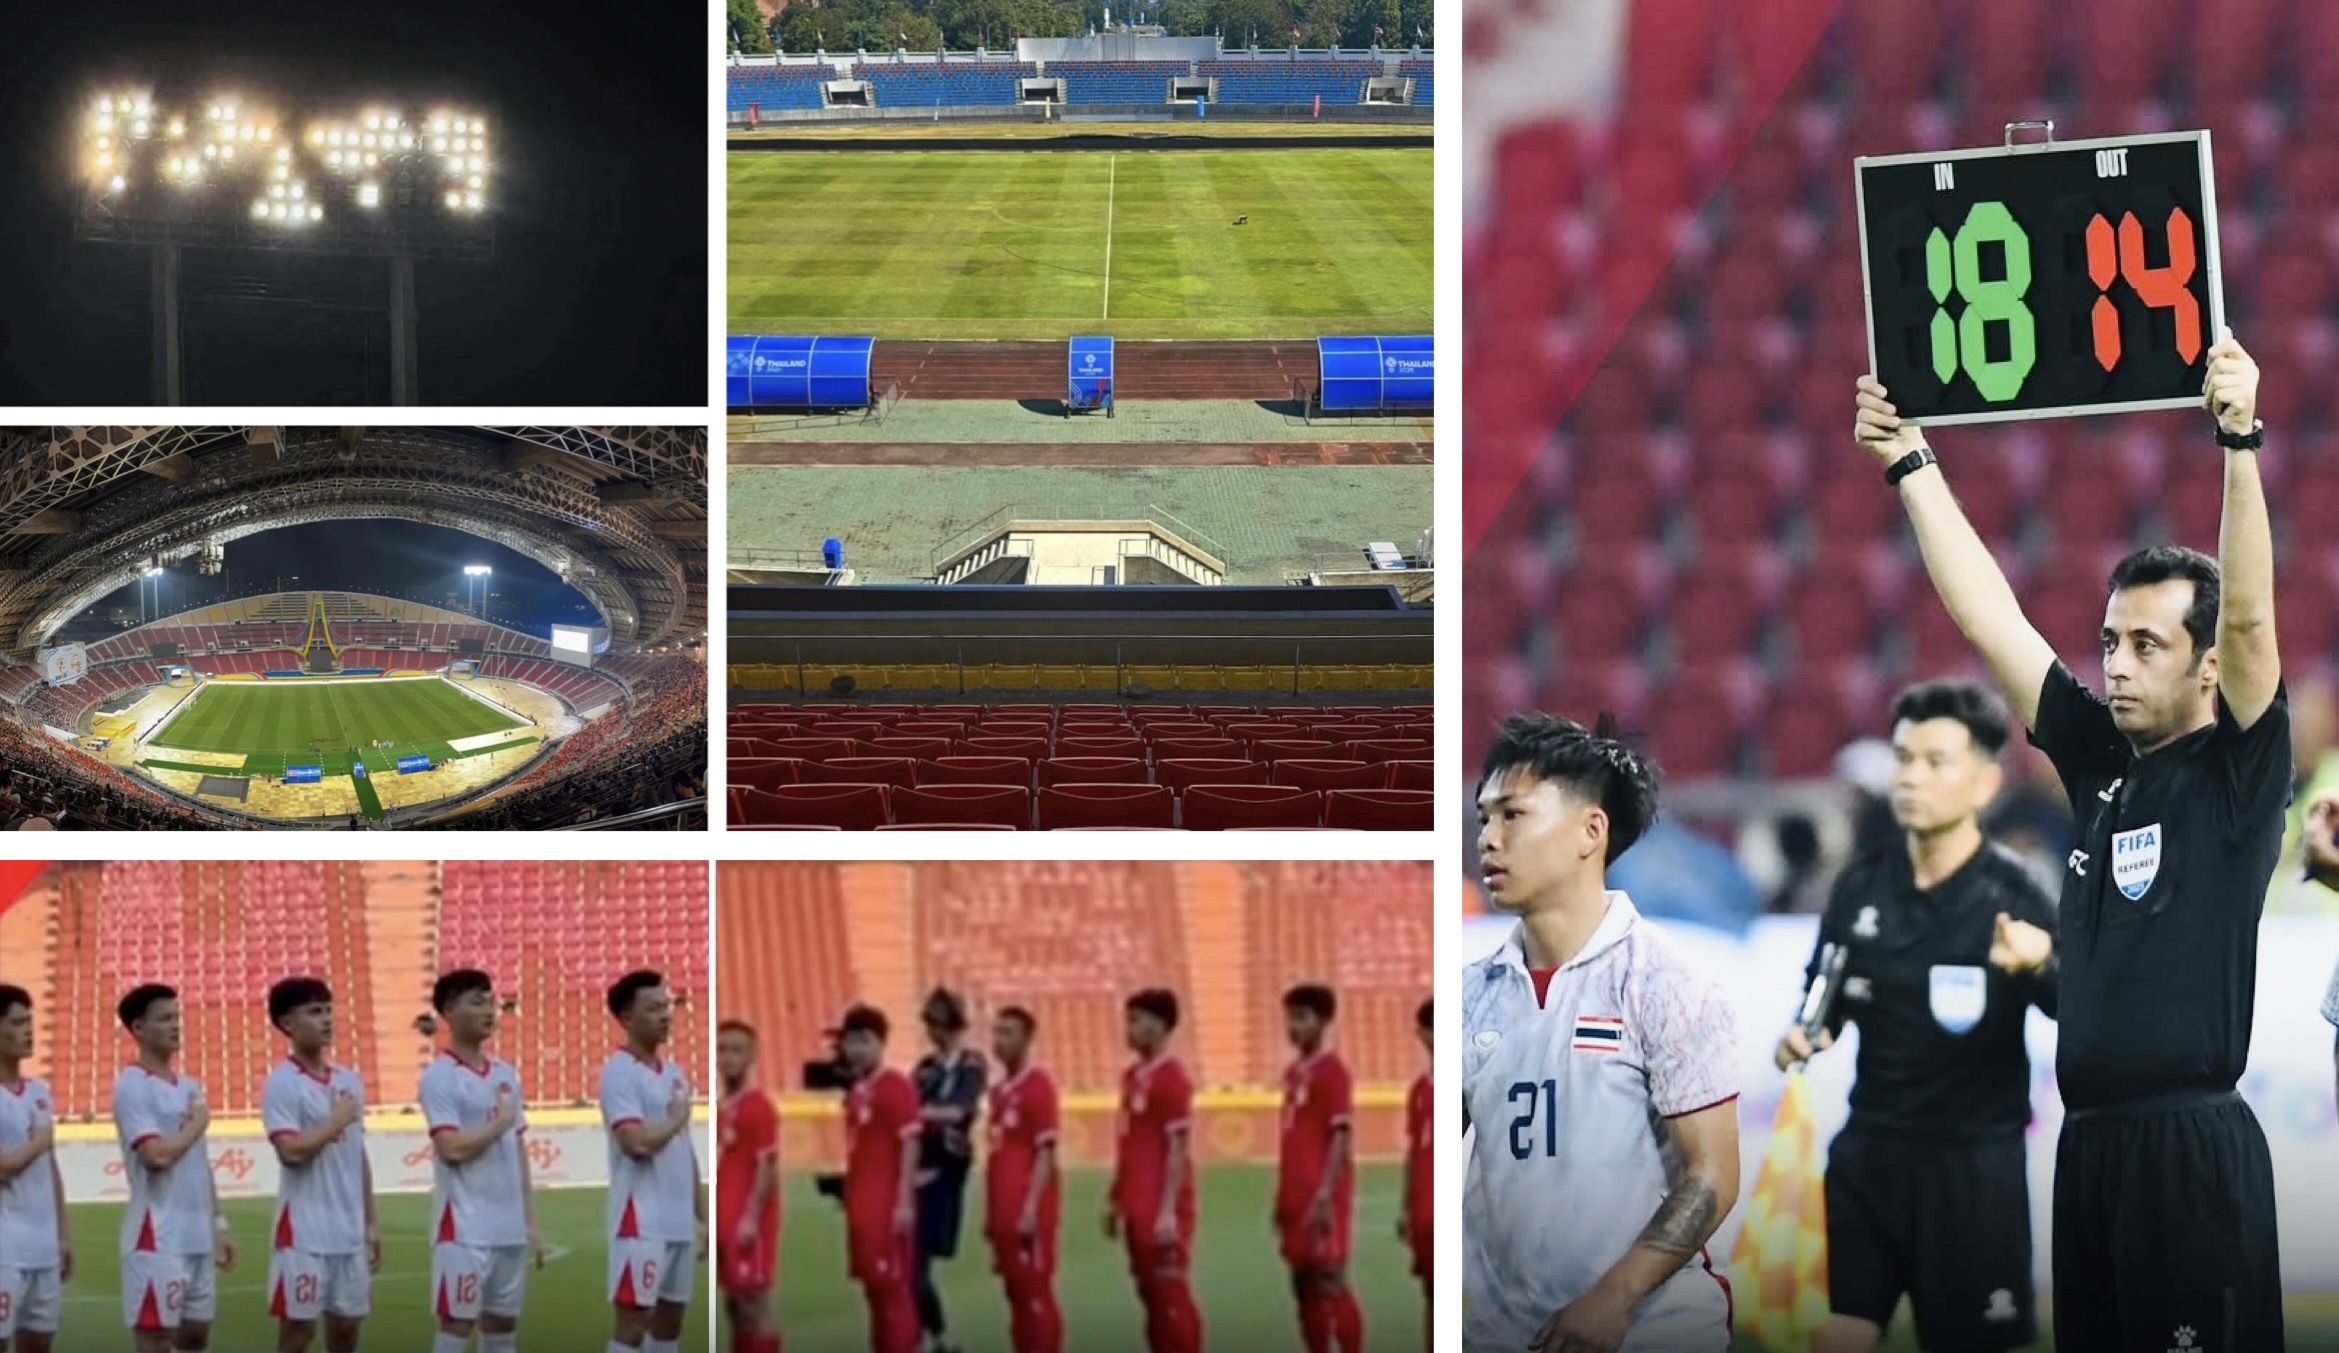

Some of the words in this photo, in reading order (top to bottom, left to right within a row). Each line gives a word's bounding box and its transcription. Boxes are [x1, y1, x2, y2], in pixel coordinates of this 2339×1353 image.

[1933, 162, 1955, 191] IN
[2095, 148, 2129, 178] OUT
[1925, 201, 2036, 402] 18
[2085, 207, 2201, 373] 14
[767, 359, 806, 368] THAILAND
[2117, 832, 2155, 854] FIFA
[2117, 857, 2155, 874] REFEREE
[1508, 1079, 1557, 1160] 21
[642, 1259, 657, 1290] 6
